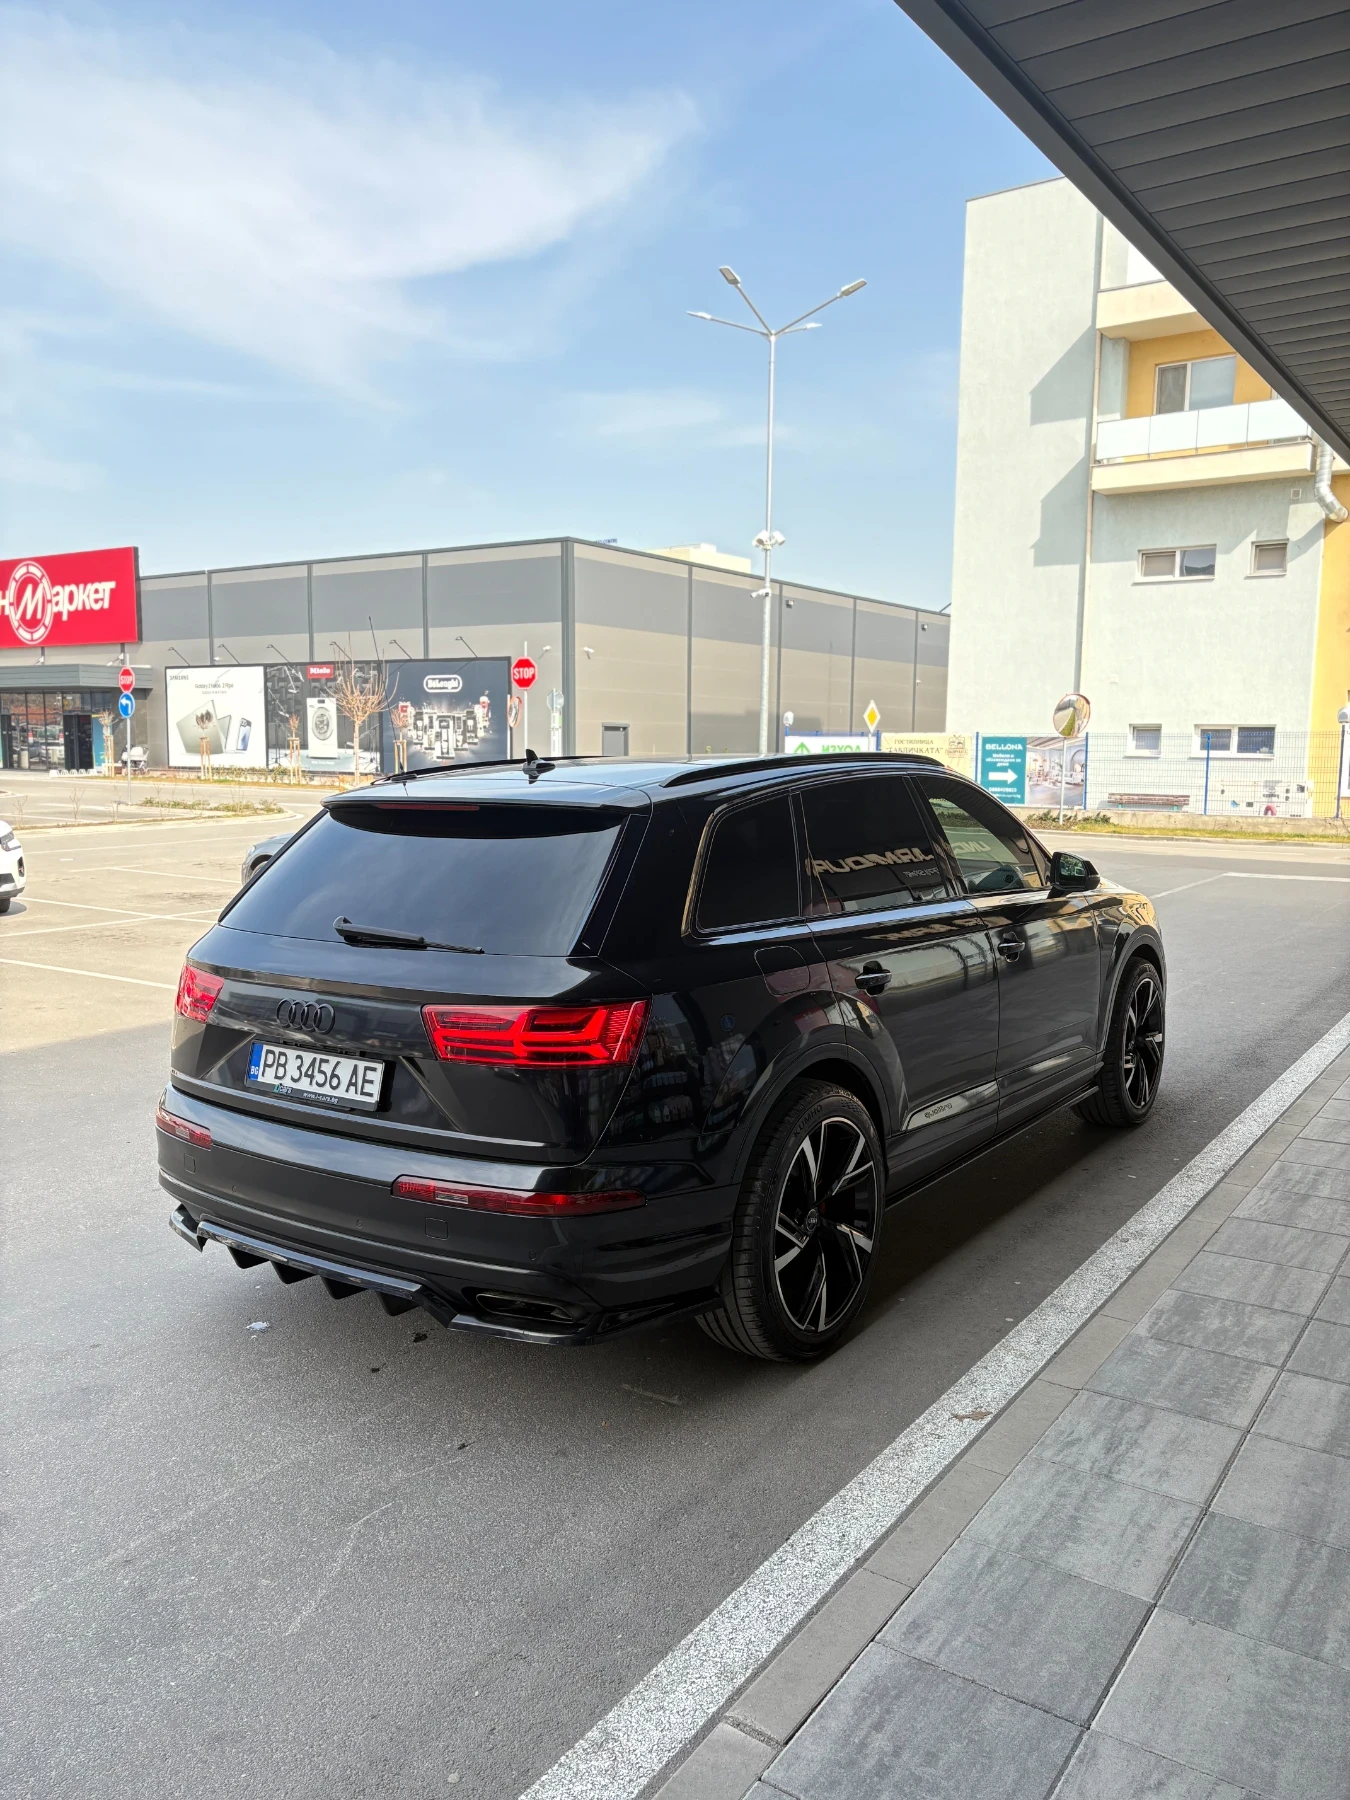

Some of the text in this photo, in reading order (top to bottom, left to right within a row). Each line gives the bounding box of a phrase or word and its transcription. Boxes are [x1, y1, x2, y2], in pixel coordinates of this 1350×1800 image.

[120, 675, 133, 685] STOP
[513, 667, 535, 680] STOP
[250, 1066, 259, 1075] BG
[261, 1049, 378, 1097] PB 3456 AE
[924, 1102, 953, 1119] quattro
[793, 1104, 823, 1138] KUMHO
